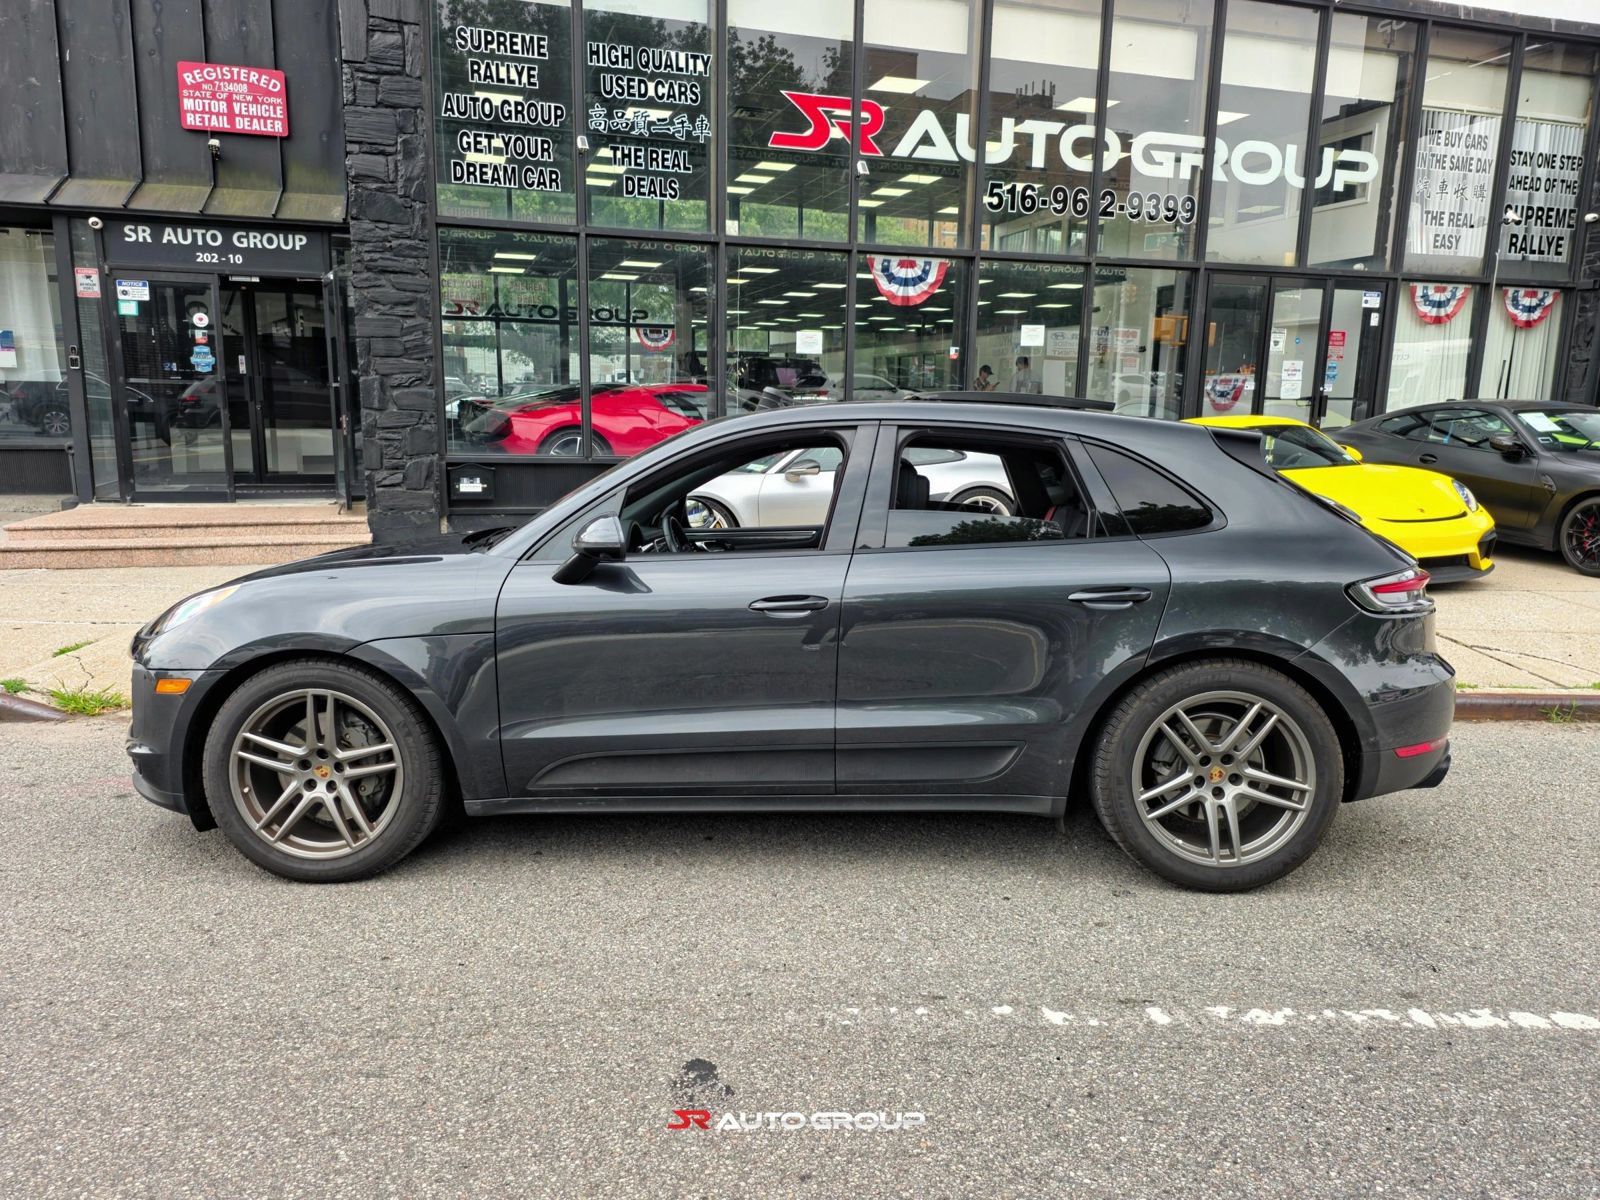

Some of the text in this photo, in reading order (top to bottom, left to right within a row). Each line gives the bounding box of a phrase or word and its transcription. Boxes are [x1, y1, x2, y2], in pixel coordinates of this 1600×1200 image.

[456, 25, 549, 60] SUPREME
[587, 42, 713, 77] HIGH QUALITY
[183, 67, 281, 92] REGISTERED
[469, 58, 539, 89] RALLYE
[182, 89, 283, 105] STATE OF NEW YORK
[601, 74, 700, 105] USED CARS
[183, 98, 284, 119] MOTOR VEHICLE
[442, 93, 565, 127] AUTO GROUP
[186, 112, 283, 133] RETAIL DEALER
[458, 130, 553, 162] GET YOUR
[768, 89, 1380, 192] SR AUTO GROUP
[1428, 129, 1489, 151] WE BUY CARS
[609, 145, 692, 173] THE REAL
[1417, 152, 1494, 174] IN THE SAME DAY
[1510, 150, 1584, 172] STAY ONE STEP
[452, 160, 561, 192] DREAM CAR
[624, 175, 679, 201] DEALS
[1508, 175, 1578, 196] AHEAD OF THE
[1424, 210, 1475, 229] THE REAL
[123, 225, 307, 251] SR AUTO GROUP
[530, 234, 564, 245] AUTO
[640, 242, 672, 251] AUO
[1432, 233, 1462, 250] EASY
[1507, 233, 1565, 257] RALLYE
[484, 303, 559, 320] AUTO
